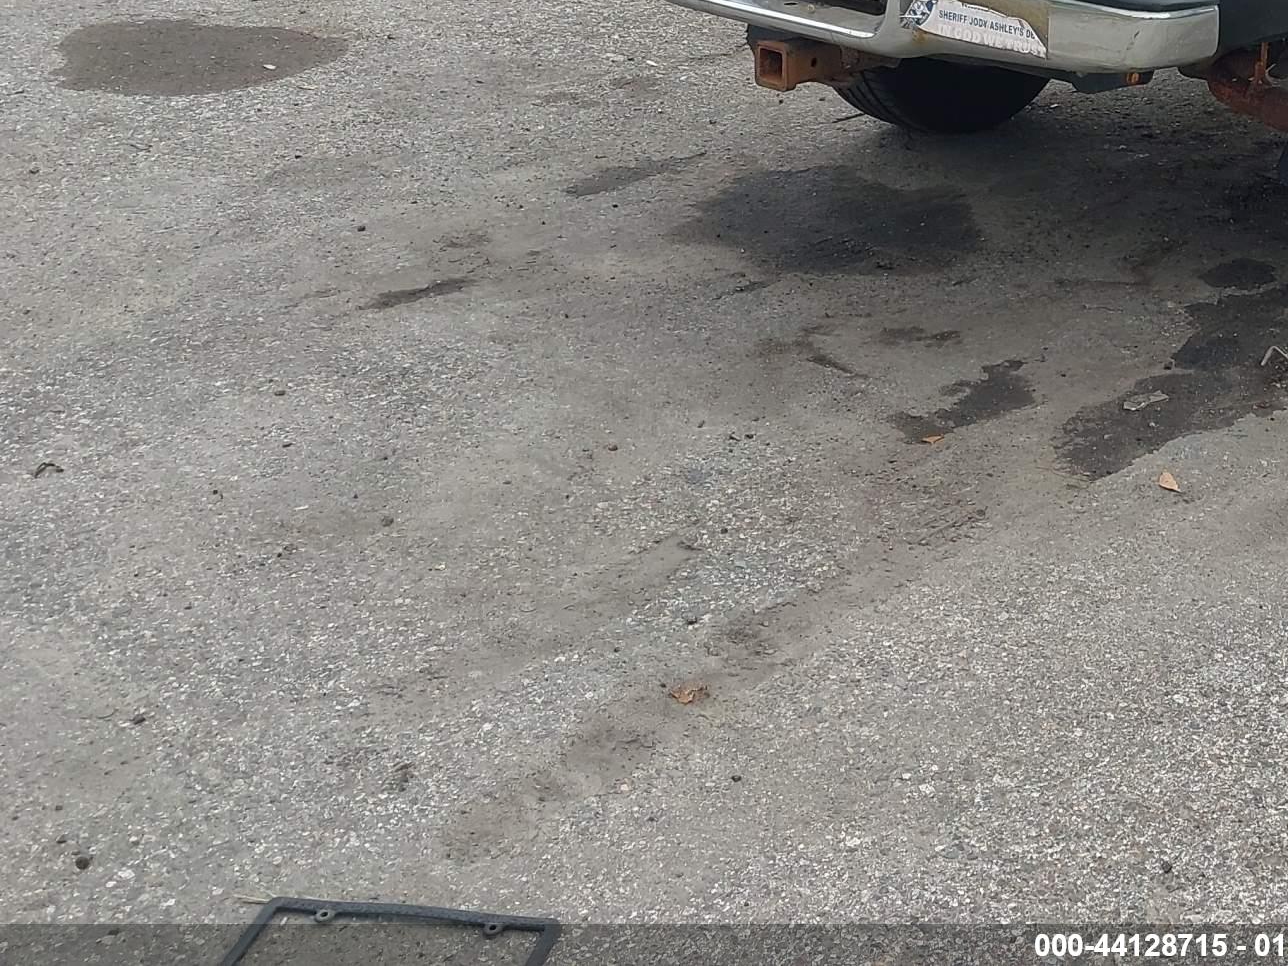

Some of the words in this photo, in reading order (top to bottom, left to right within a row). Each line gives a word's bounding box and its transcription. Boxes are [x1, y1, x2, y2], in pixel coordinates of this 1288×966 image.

[938, 9, 967, 24] SHERIFF
[969, 17, 988, 28] JODY
[990, 20, 1024, 37] ASHLEY'S
